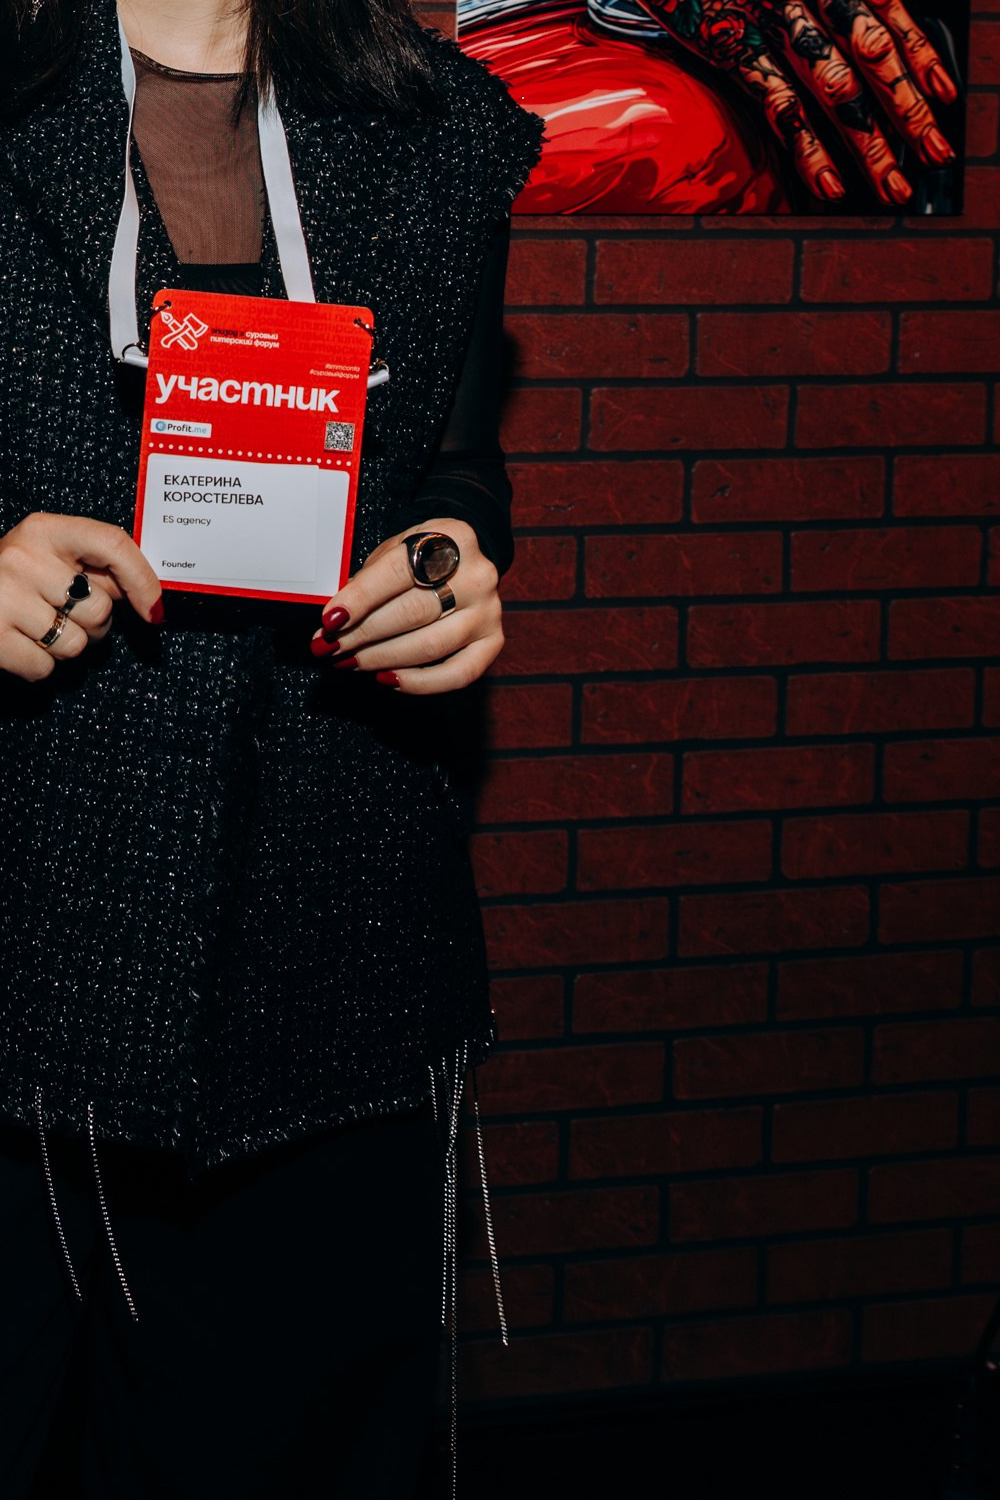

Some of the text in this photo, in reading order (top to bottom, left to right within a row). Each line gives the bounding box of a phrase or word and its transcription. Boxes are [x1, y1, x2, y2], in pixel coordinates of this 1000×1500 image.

[245, 331, 279, 340] суровый
[210, 336, 280, 349] питерский форум
[154, 372, 340, 414] участник
[164, 474, 242, 488] ЕКАТЕРИНА
[163, 491, 264, 506] КОРОСТЕЛЕВА
[163, 515, 211, 526] ES agency
[162, 560, 196, 569] Founder
